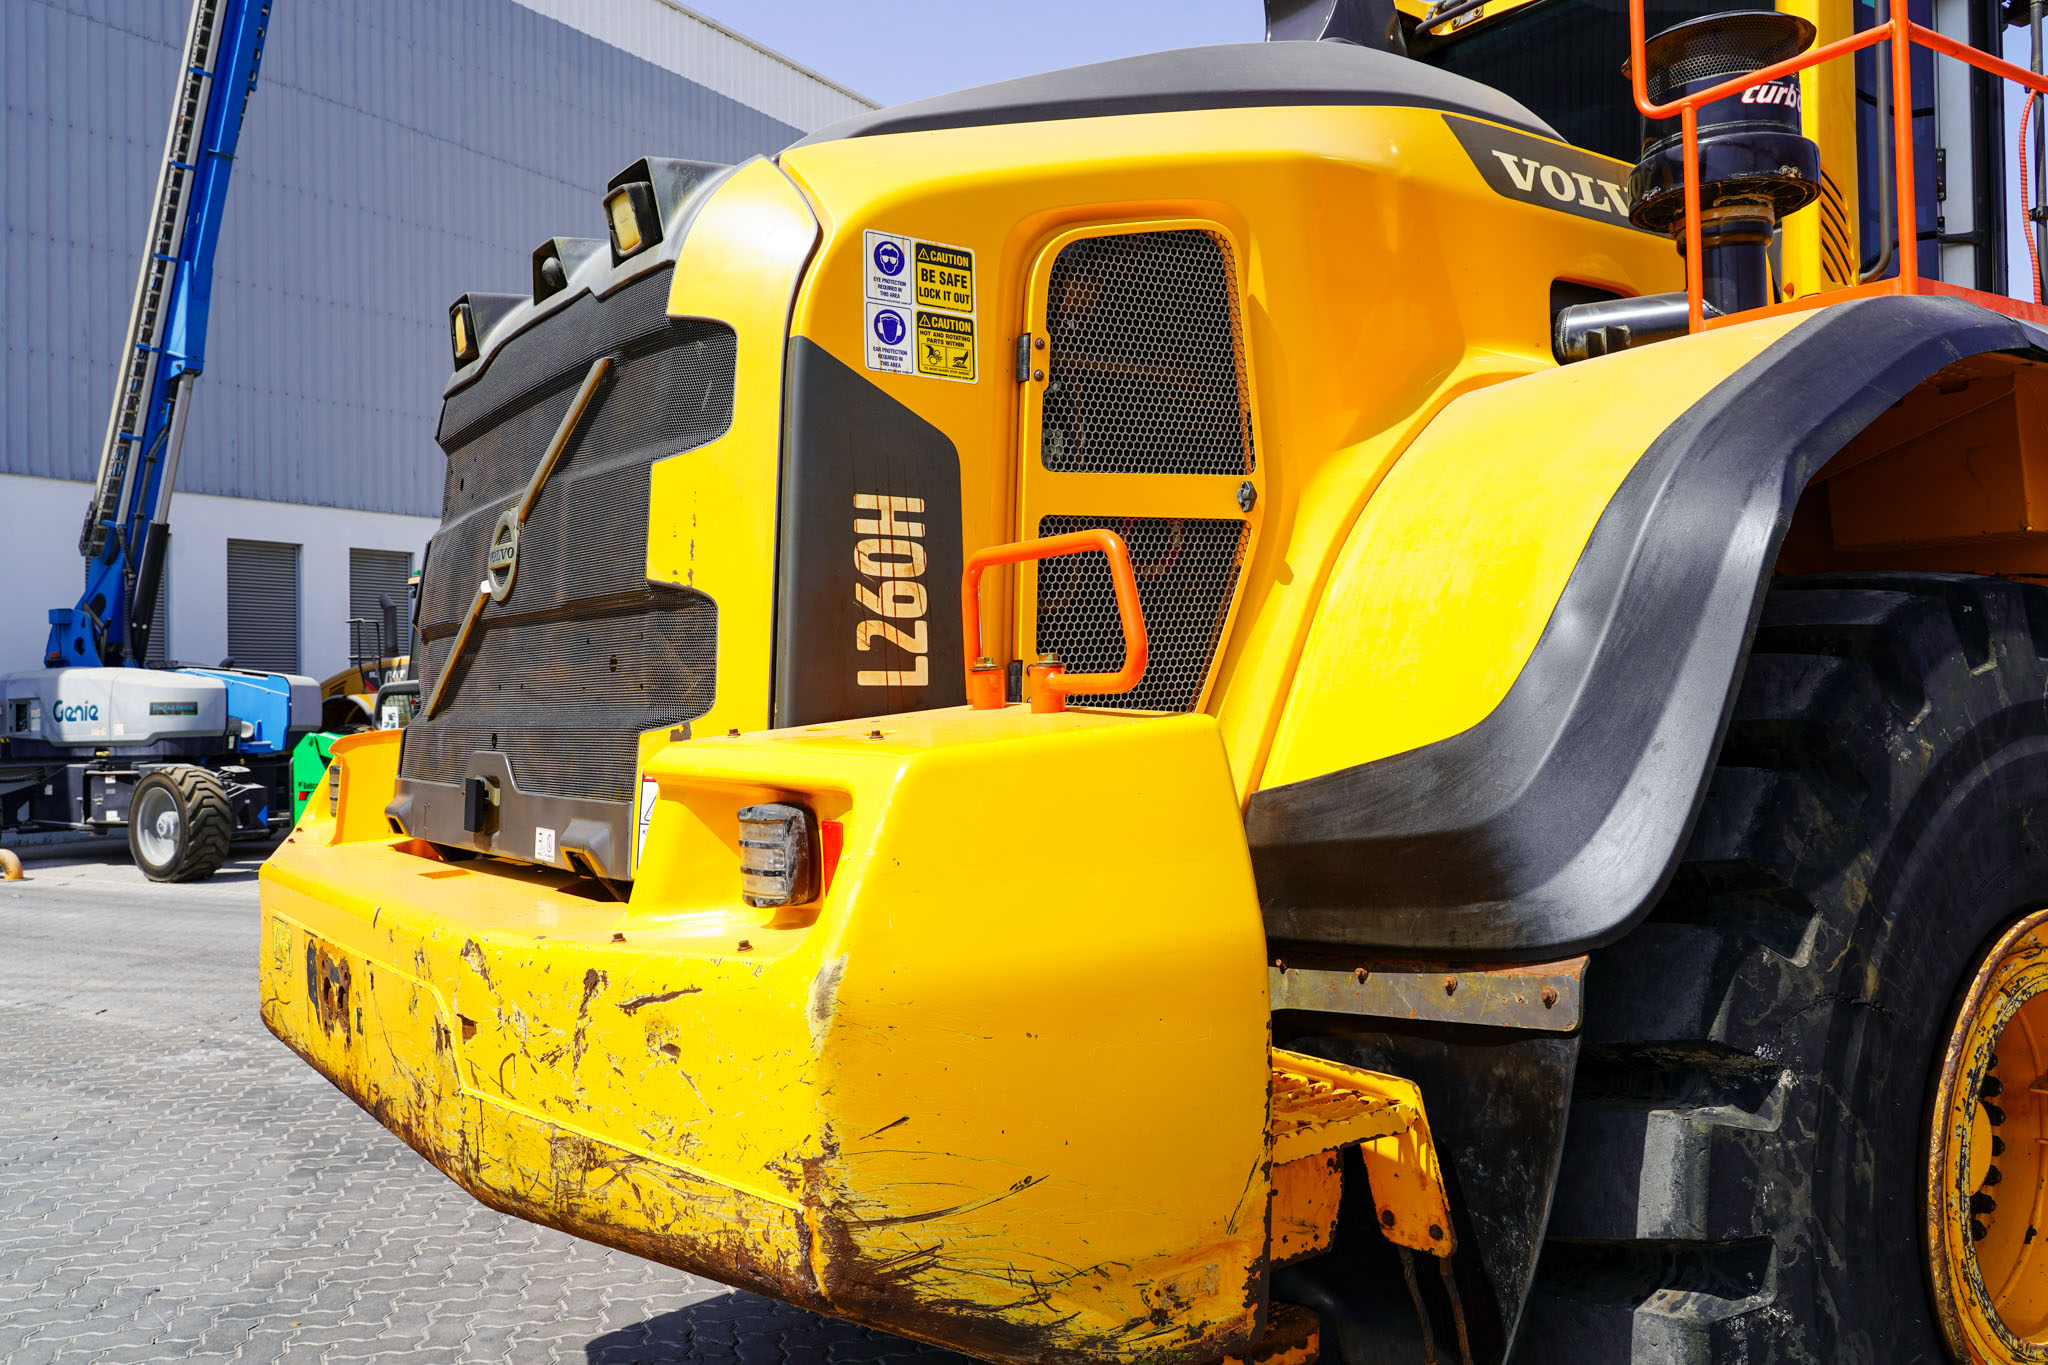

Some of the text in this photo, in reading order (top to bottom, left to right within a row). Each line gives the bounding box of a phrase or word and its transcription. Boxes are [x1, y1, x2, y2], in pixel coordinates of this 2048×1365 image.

[1492, 149, 1629, 218] VOLV
[930, 250, 969, 267] CAUTION
[882, 278, 906, 286] PROTECTION
[921, 268, 967, 289] BE SAFE
[919, 287, 969, 304] LOCK IT OUT
[932, 317, 971, 332] CAUTION
[946, 334, 970, 342] ROTATING
[882, 347, 907, 355] PROTECTION
[490, 547, 514, 562] VOLVO
[853, 494, 928, 686] L260H
[385, 670, 406, 683] CAT
[53, 699, 99, 722] Genie
